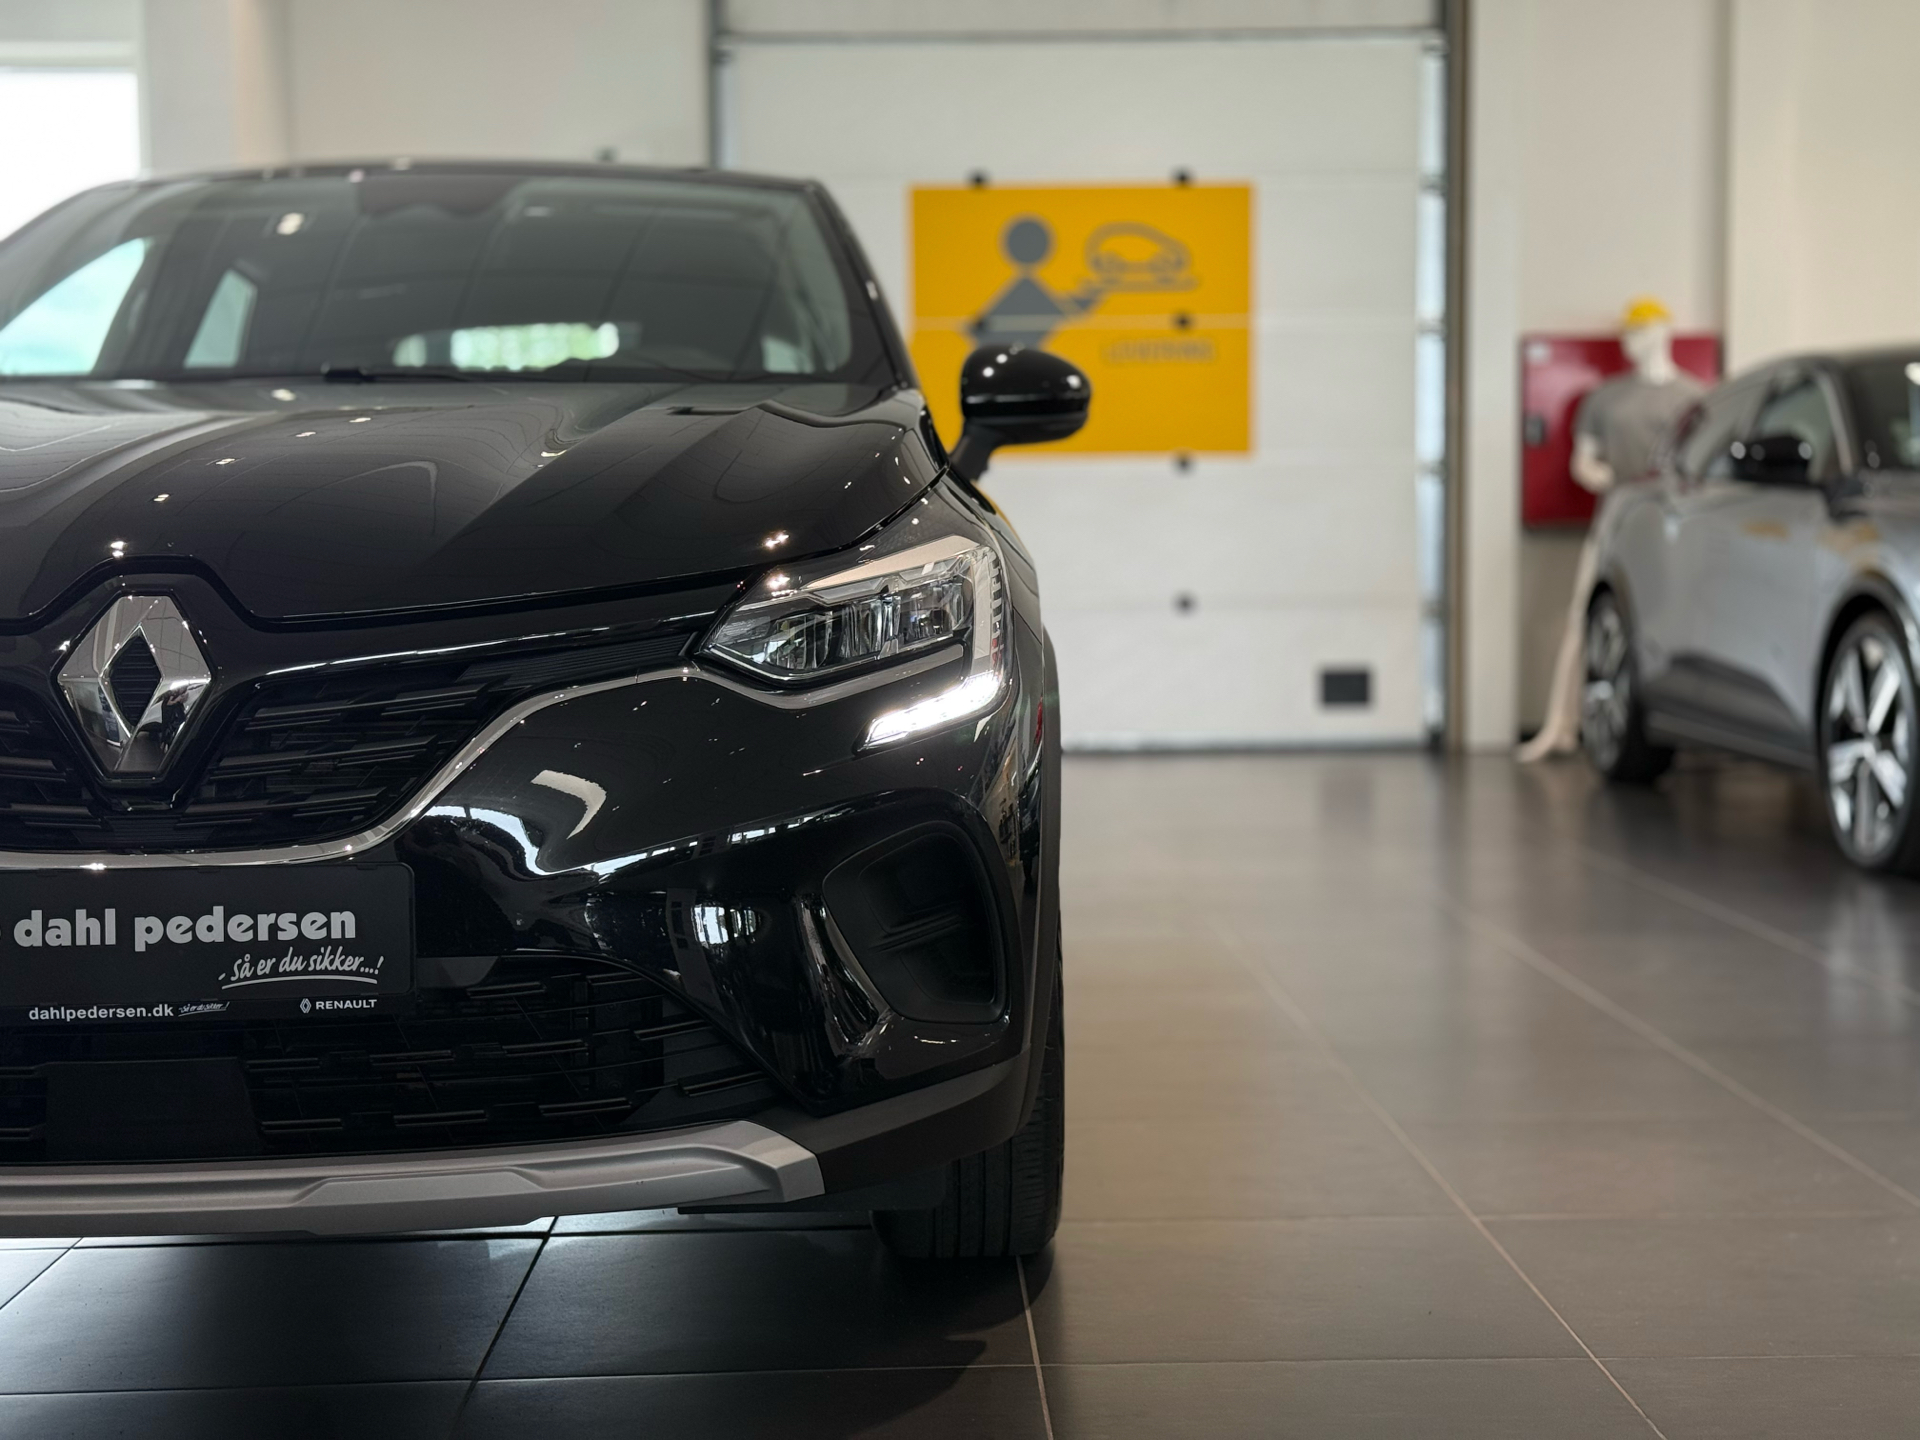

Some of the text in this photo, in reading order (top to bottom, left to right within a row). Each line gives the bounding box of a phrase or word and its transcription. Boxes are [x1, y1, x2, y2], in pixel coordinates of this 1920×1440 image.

[14, 905, 356, 952] dahl pedersen
[256, 957, 276, 976] er
[278, 946, 307, 973] du
[29, 1003, 174, 1022] dahlpedersen.dk
[315, 999, 378, 1010] RENAULT
